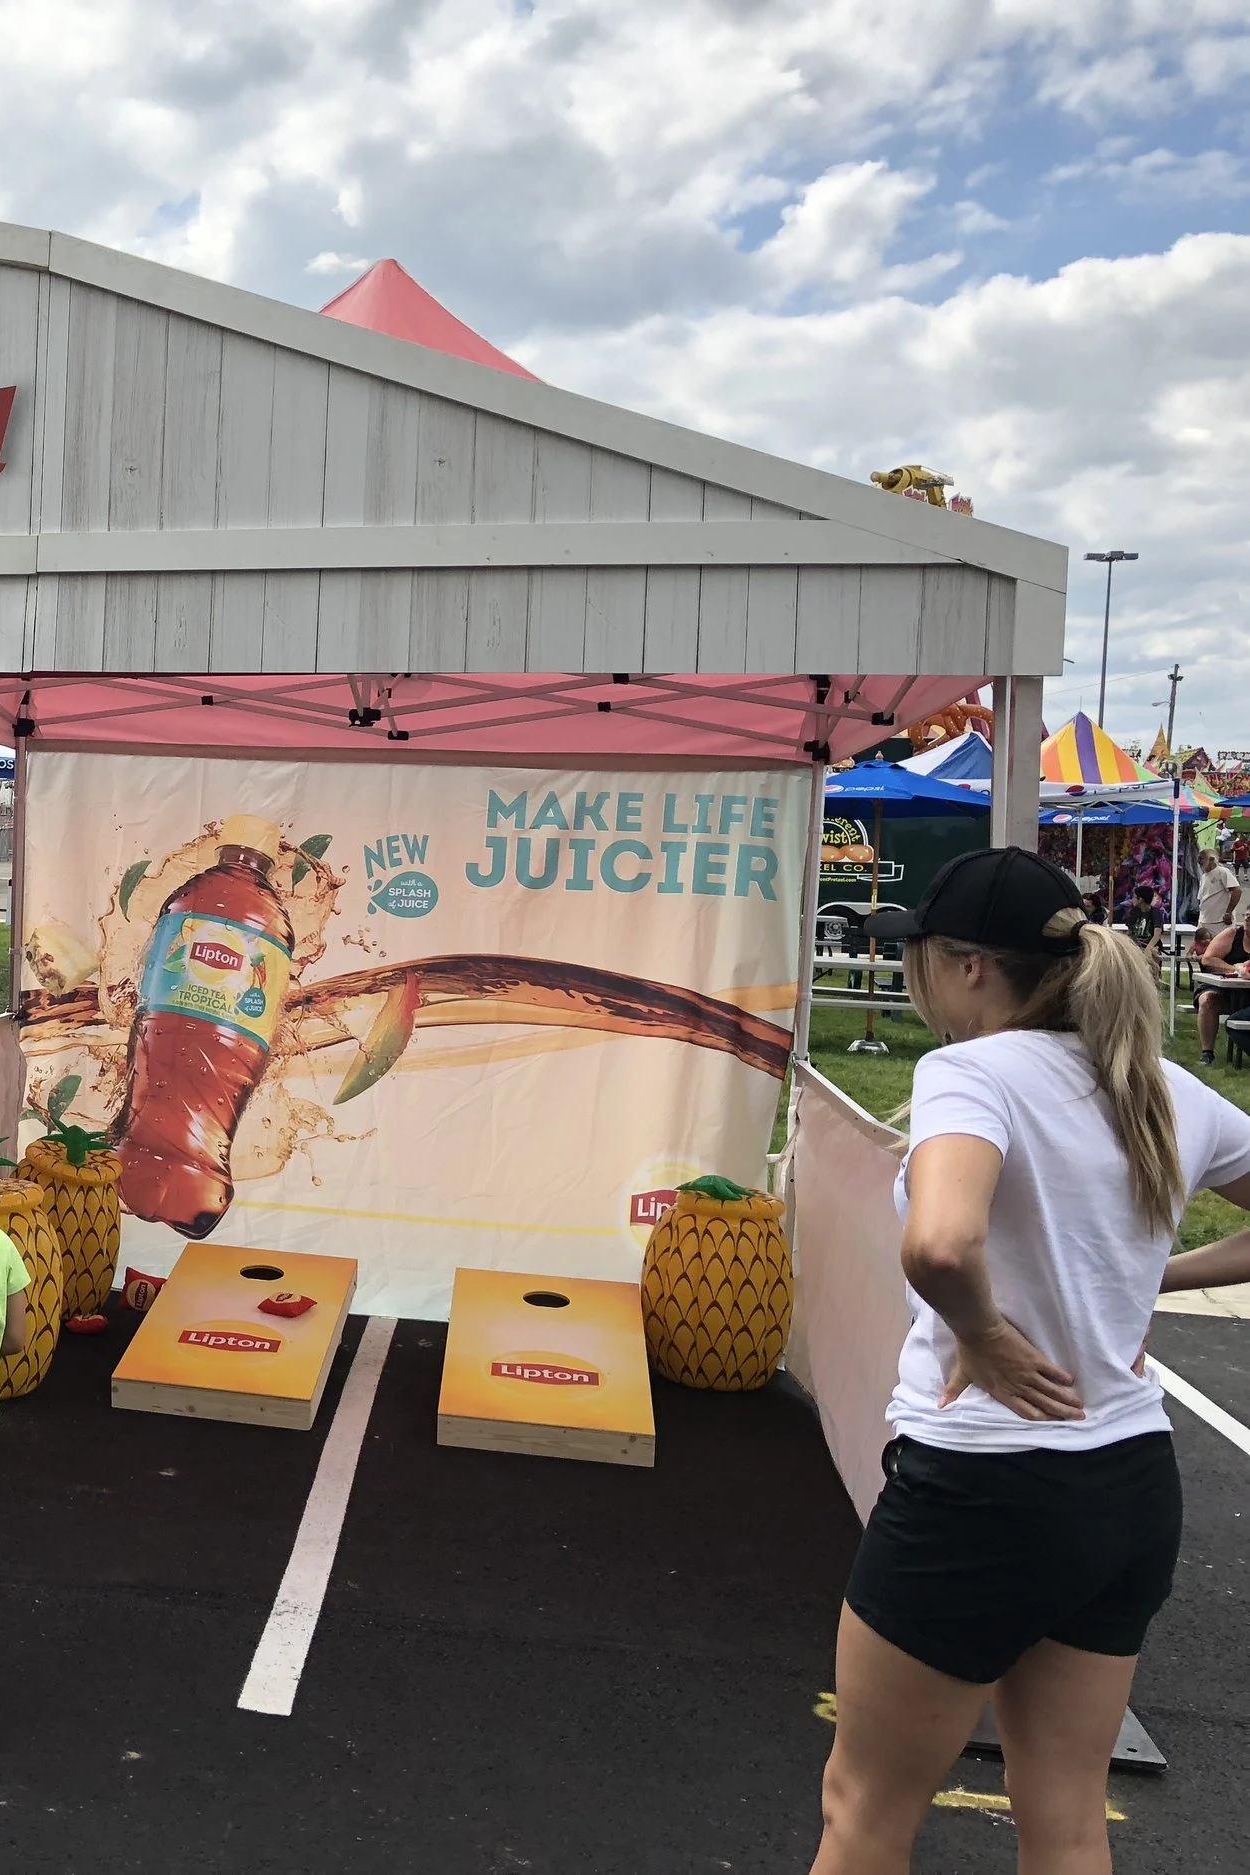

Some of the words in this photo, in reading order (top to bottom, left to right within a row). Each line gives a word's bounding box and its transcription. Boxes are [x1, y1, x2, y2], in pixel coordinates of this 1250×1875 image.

[486, 789, 644, 832] MAKE
[662, 792, 779, 839] LIFE
[363, 834, 430, 879] NEW
[465, 835, 779, 901] JUICIER
[842, 864, 868, 872] CO.
[388, 887, 432, 898] SPLASH
[397, 899, 429, 909] JUICE
[195, 945, 239, 967] Lipton
[179, 990, 233, 1014] TROPICAL
[187, 984, 209, 996] ICED
[210, 989, 227, 1001] TEA
[187, 1332, 271, 1352] Lipton
[500, 1363, 590, 1384] Lipton
